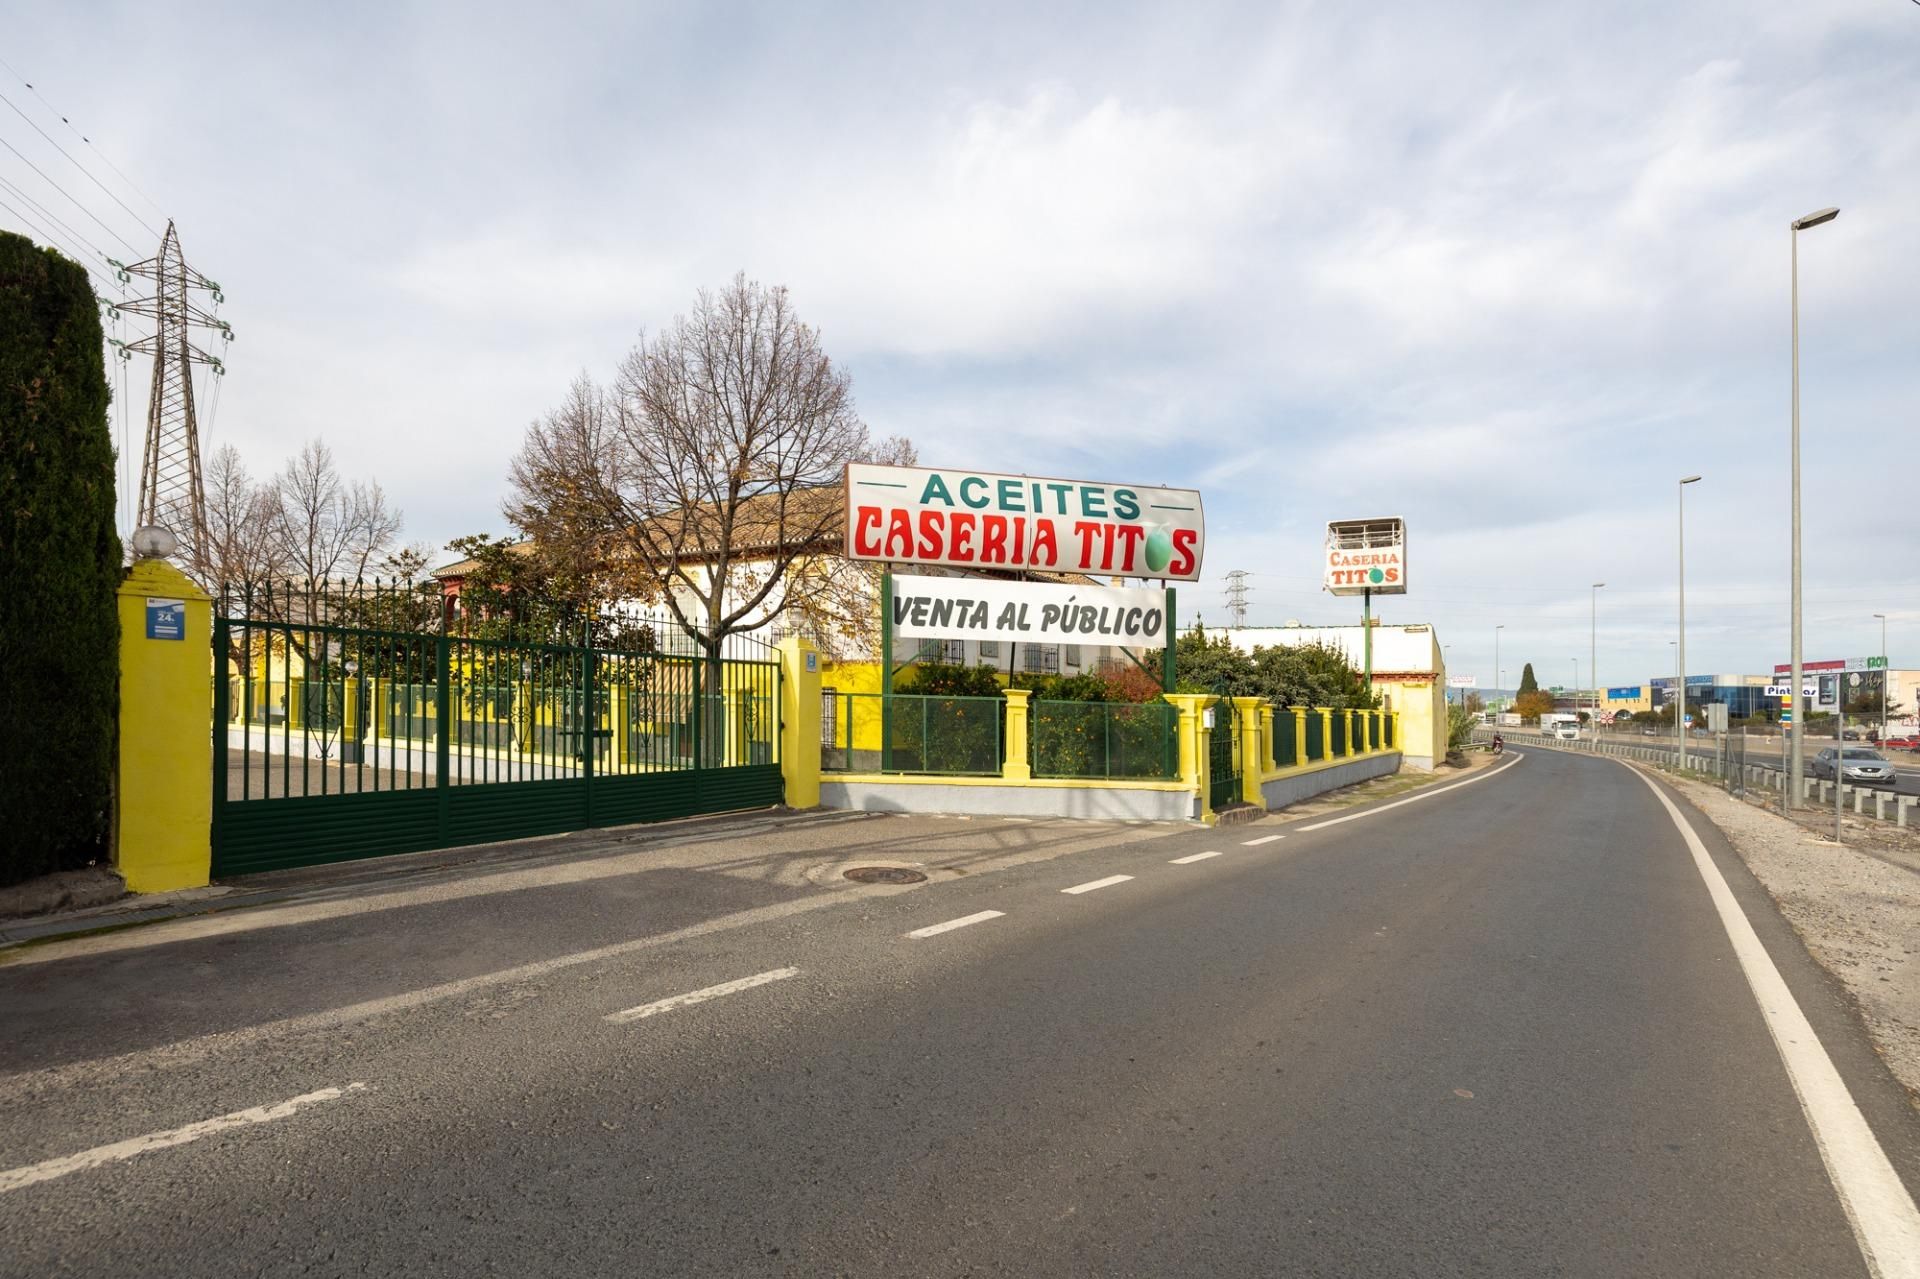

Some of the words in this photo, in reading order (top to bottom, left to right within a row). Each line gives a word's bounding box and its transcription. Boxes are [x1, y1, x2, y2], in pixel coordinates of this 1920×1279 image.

[919, 473, 1142, 521] ACEITES
[854, 505, 1058, 567] CASERIA
[1330, 551, 1399, 566] CASERIA
[893, 596, 989, 629] VENTA
[996, 601, 1032, 631] AL
[1040, 595, 1163, 637] PÚBLICO
[1768, 687, 1816, 696] Pintas
